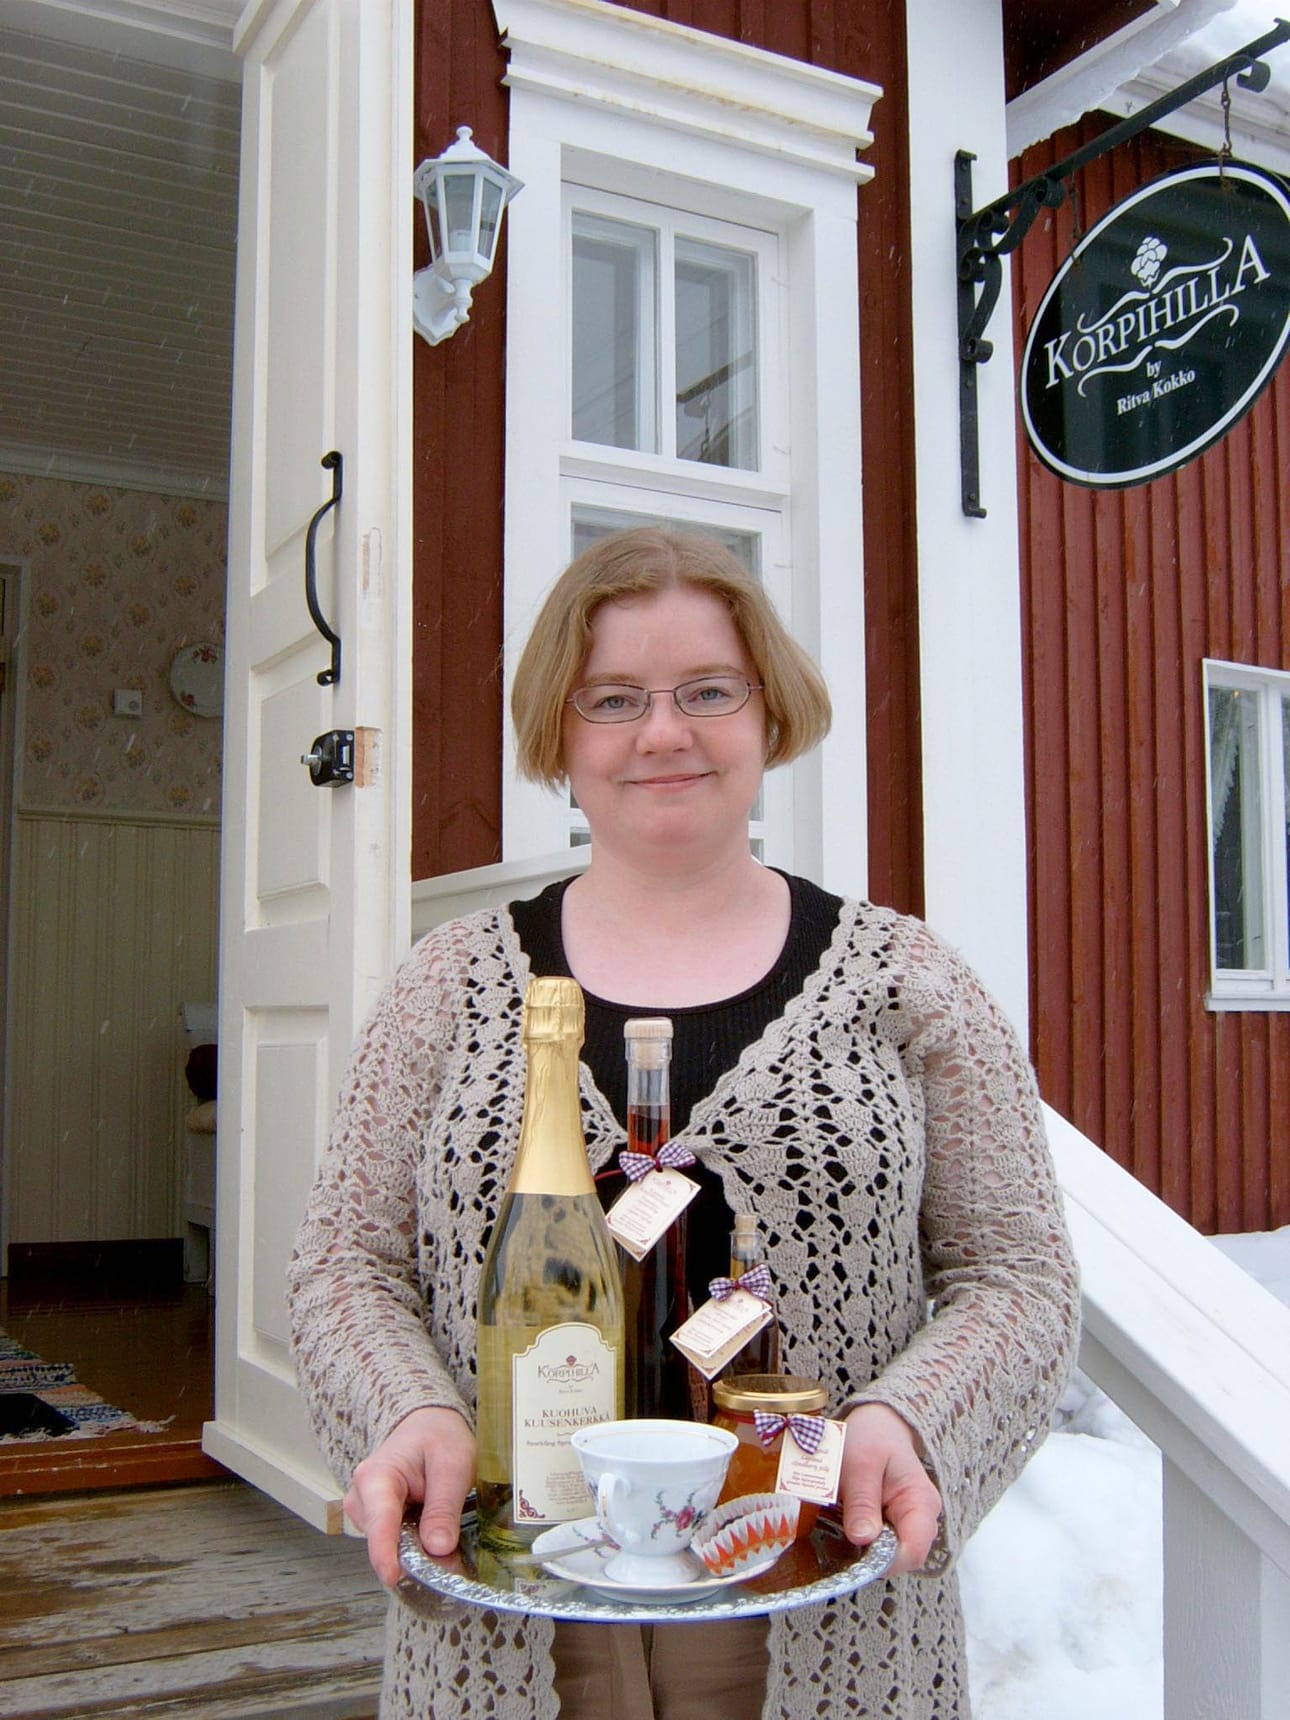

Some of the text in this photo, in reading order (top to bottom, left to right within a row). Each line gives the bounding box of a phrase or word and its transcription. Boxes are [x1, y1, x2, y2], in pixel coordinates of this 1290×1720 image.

[1043, 235, 1272, 390] KORPIHILLA
[1146, 360, 1162, 378] by
[1116, 368, 1196, 416] Ritva Kokko
[541, 1406, 597, 1419] KUOHUVA
